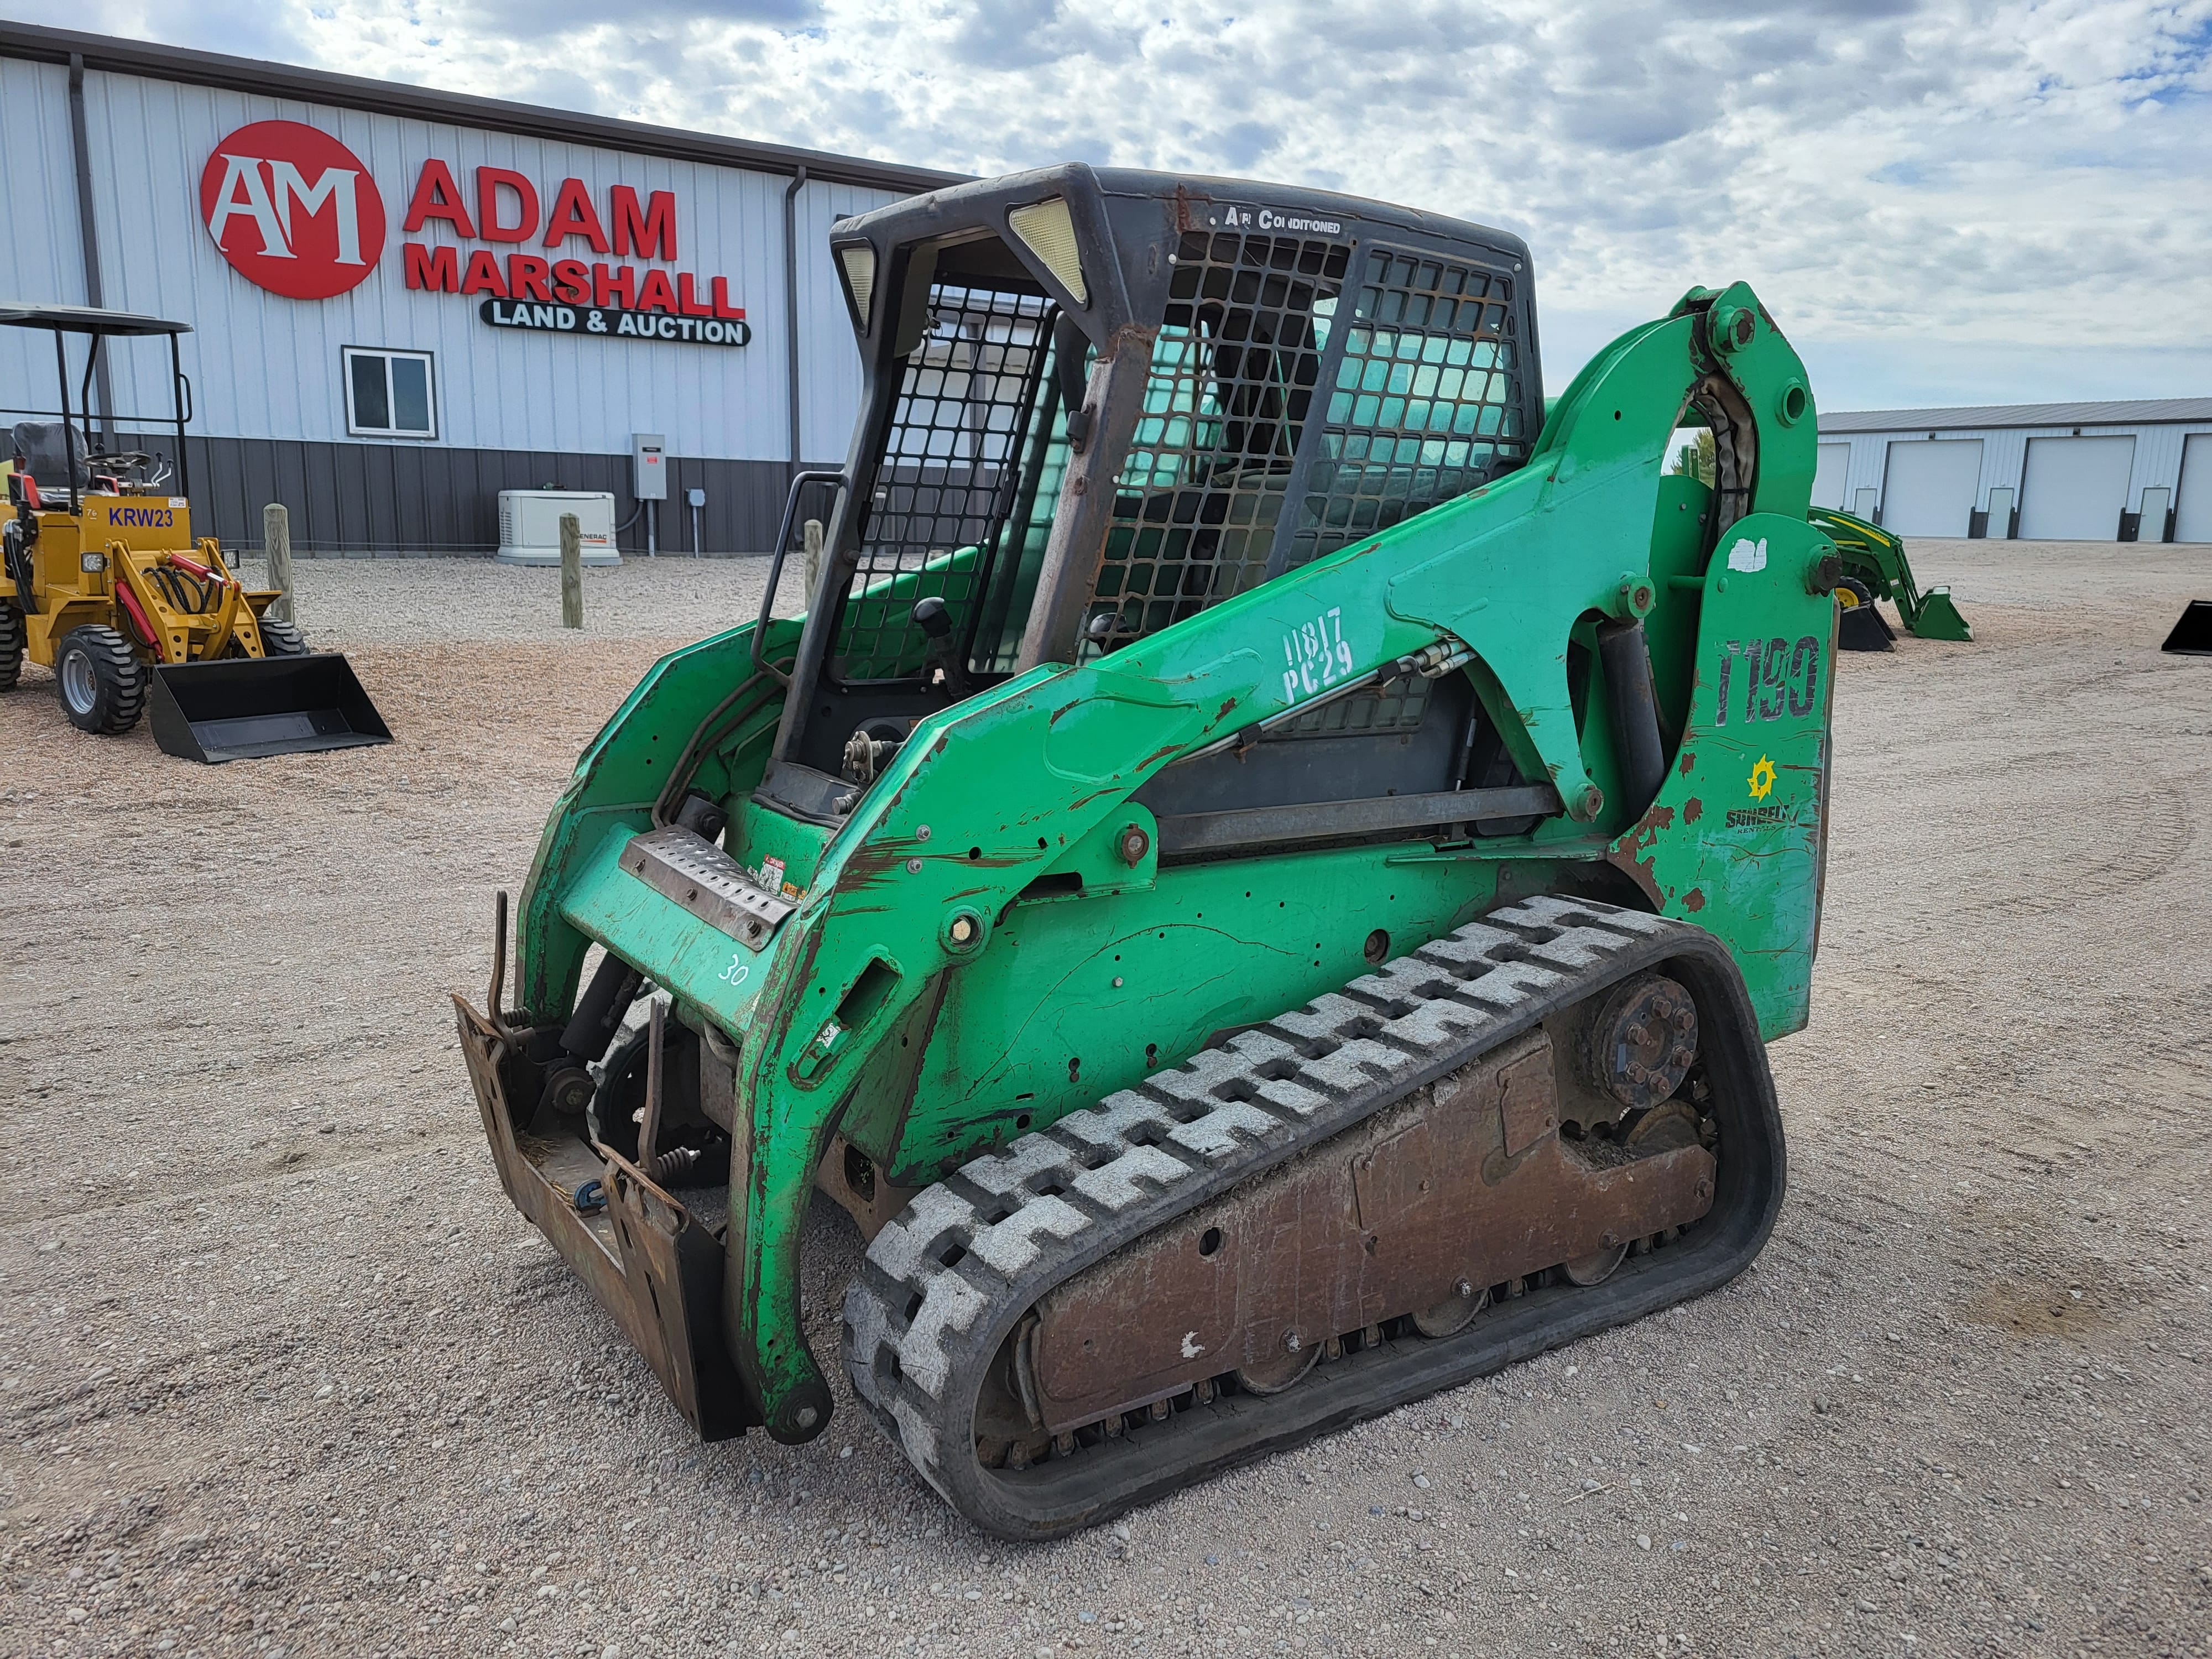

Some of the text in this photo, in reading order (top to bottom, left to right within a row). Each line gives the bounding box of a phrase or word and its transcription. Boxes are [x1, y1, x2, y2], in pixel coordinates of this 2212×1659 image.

[208, 153, 367, 267] AM
[402, 158, 677, 262] ADAM
[404, 242, 747, 320] MARSHALL
[492, 299, 744, 345] LAND & AUCTION
[86, 508, 97, 517] 76
[109, 507, 174, 527] KRW23
[1282, 640, 1353, 705] PC29
[1715, 635, 1819, 727] T190
[718, 953, 749, 986] 30
